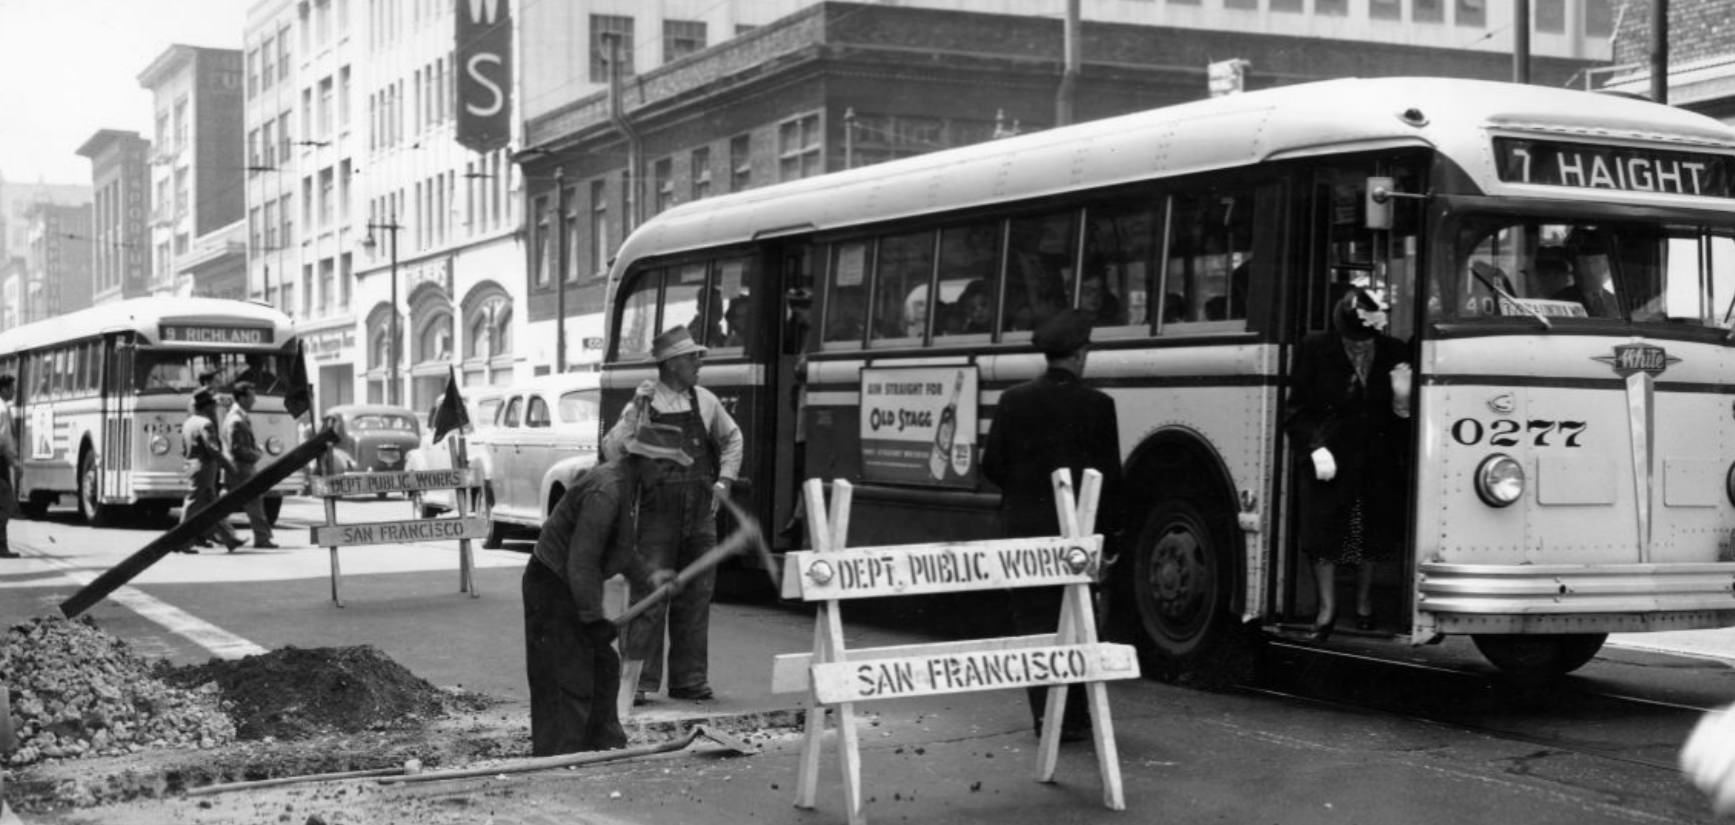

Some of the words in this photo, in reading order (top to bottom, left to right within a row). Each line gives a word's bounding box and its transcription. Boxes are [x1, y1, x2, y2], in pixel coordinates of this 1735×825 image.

[1513, 149, 1531, 183] 7
[1557, 152, 1705, 195] HAIGHT
[1220, 197, 1235, 227] 7
[166, 327, 176, 341] 9
[186, 327, 261, 343] RICHLAND
[1620, 348, 1664, 369] White
[885, 382, 923, 395] STRAIGHT
[926, 382, 943, 396] FOR
[1451, 418, 1587, 448] 0277
[368, 474, 412, 492] PUBLIC
[415, 471, 461, 488] WORKS
[344, 527, 373, 543] SAN
[380, 521, 464, 541] FRANCISCO
[908, 551, 989, 585] PUBLIC
[998, 546, 1090, 579] WORK
[857, 663, 914, 697] SAN
[927, 649, 1086, 689] FRANCISCO
